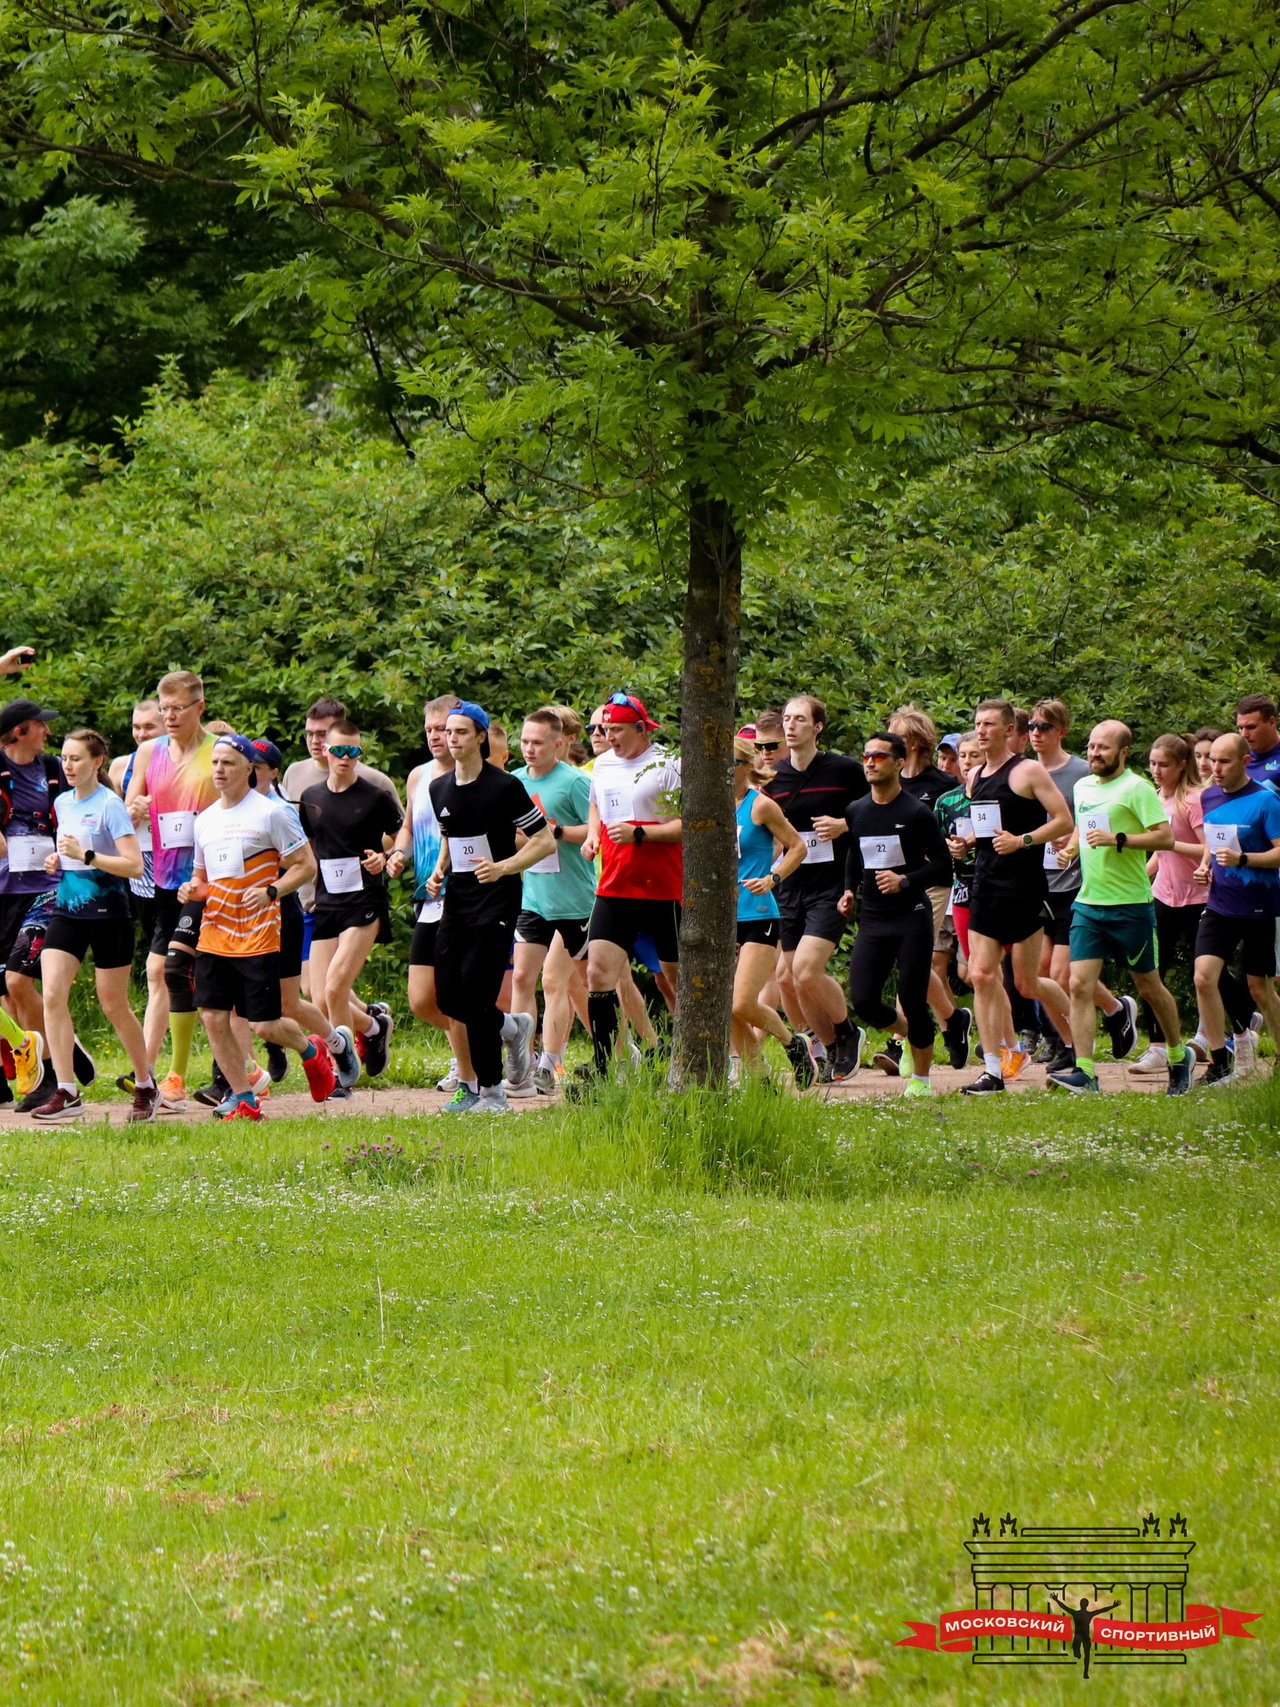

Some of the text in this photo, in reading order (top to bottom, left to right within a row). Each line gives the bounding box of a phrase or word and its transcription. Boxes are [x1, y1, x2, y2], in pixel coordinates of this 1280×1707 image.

[611, 799, 619, 807] 11
[978, 813, 986, 821] 34
[174, 823, 183, 832] 47
[1088, 820, 1096, 829] 60
[1216, 832, 1225, 841] 42
[807, 839, 817, 848] 10
[31, 847, 35, 855] 1
[463, 845, 474, 855] 20
[876, 844, 887, 853] 22
[218, 854, 227, 862] 19
[334, 870, 344, 878] 17
